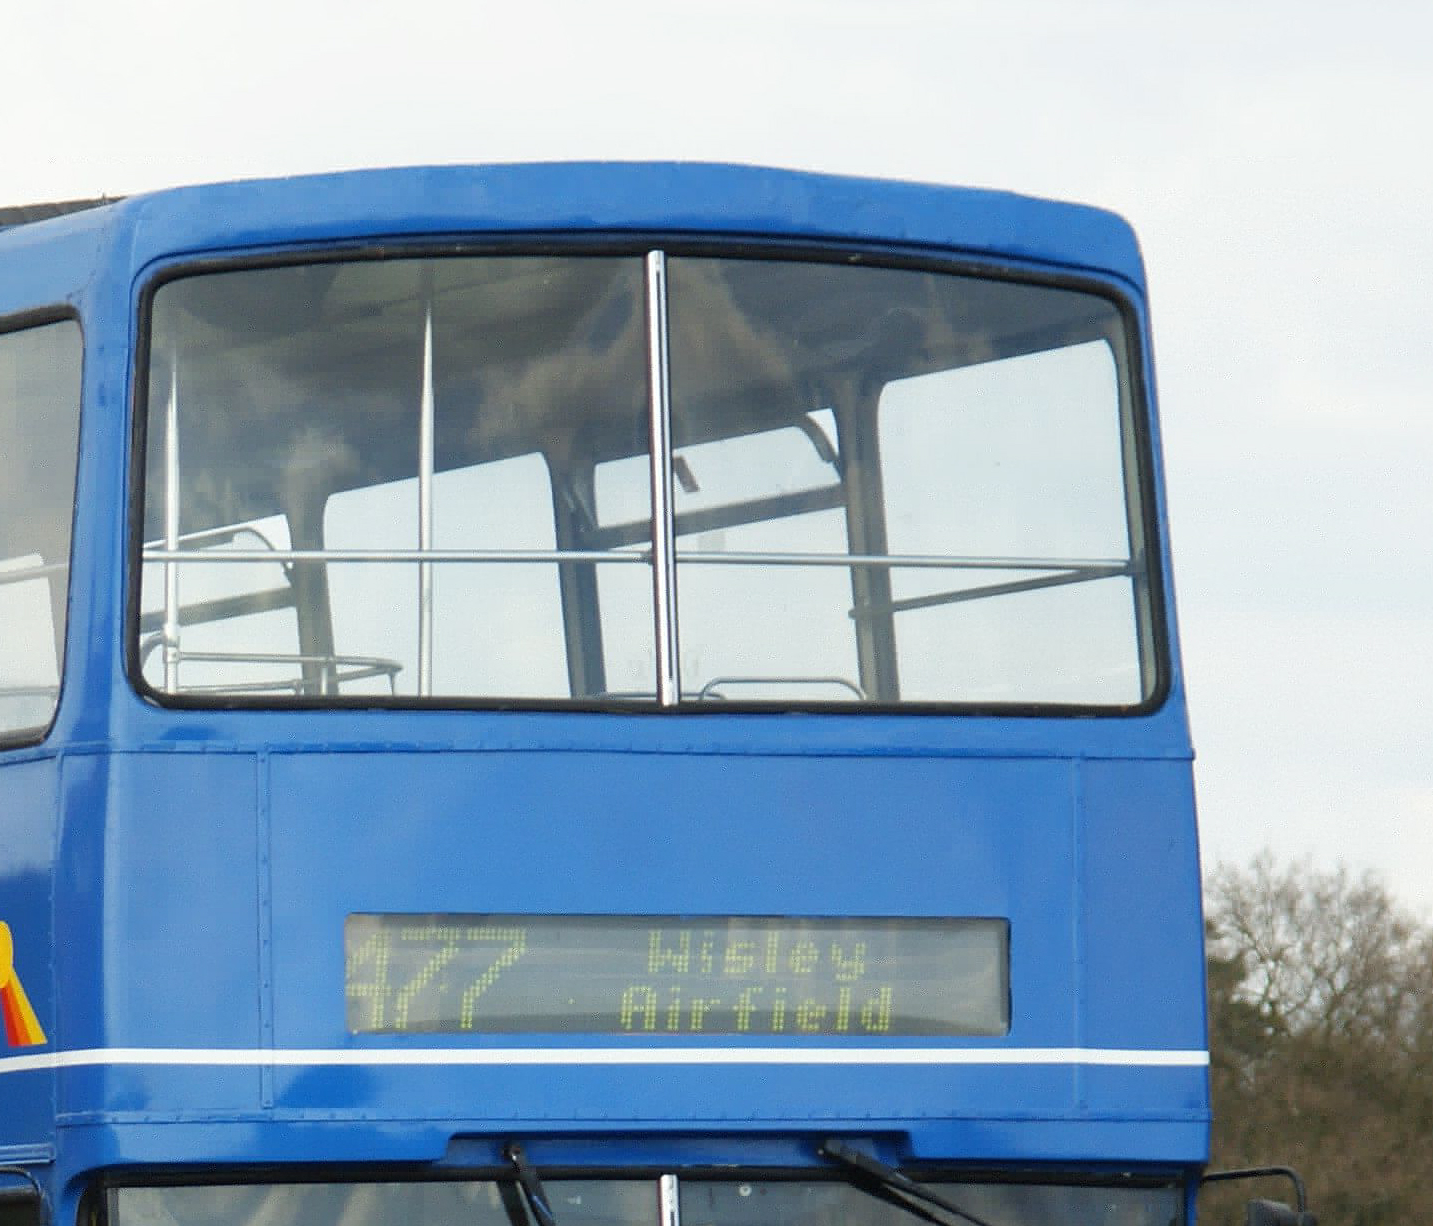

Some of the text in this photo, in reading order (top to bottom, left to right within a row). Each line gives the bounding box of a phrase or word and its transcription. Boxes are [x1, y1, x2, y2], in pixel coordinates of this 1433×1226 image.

[346, 926, 526, 1029] 477
[648, 930, 866, 981] Wisley
[620, 986, 891, 1031] Airfield
